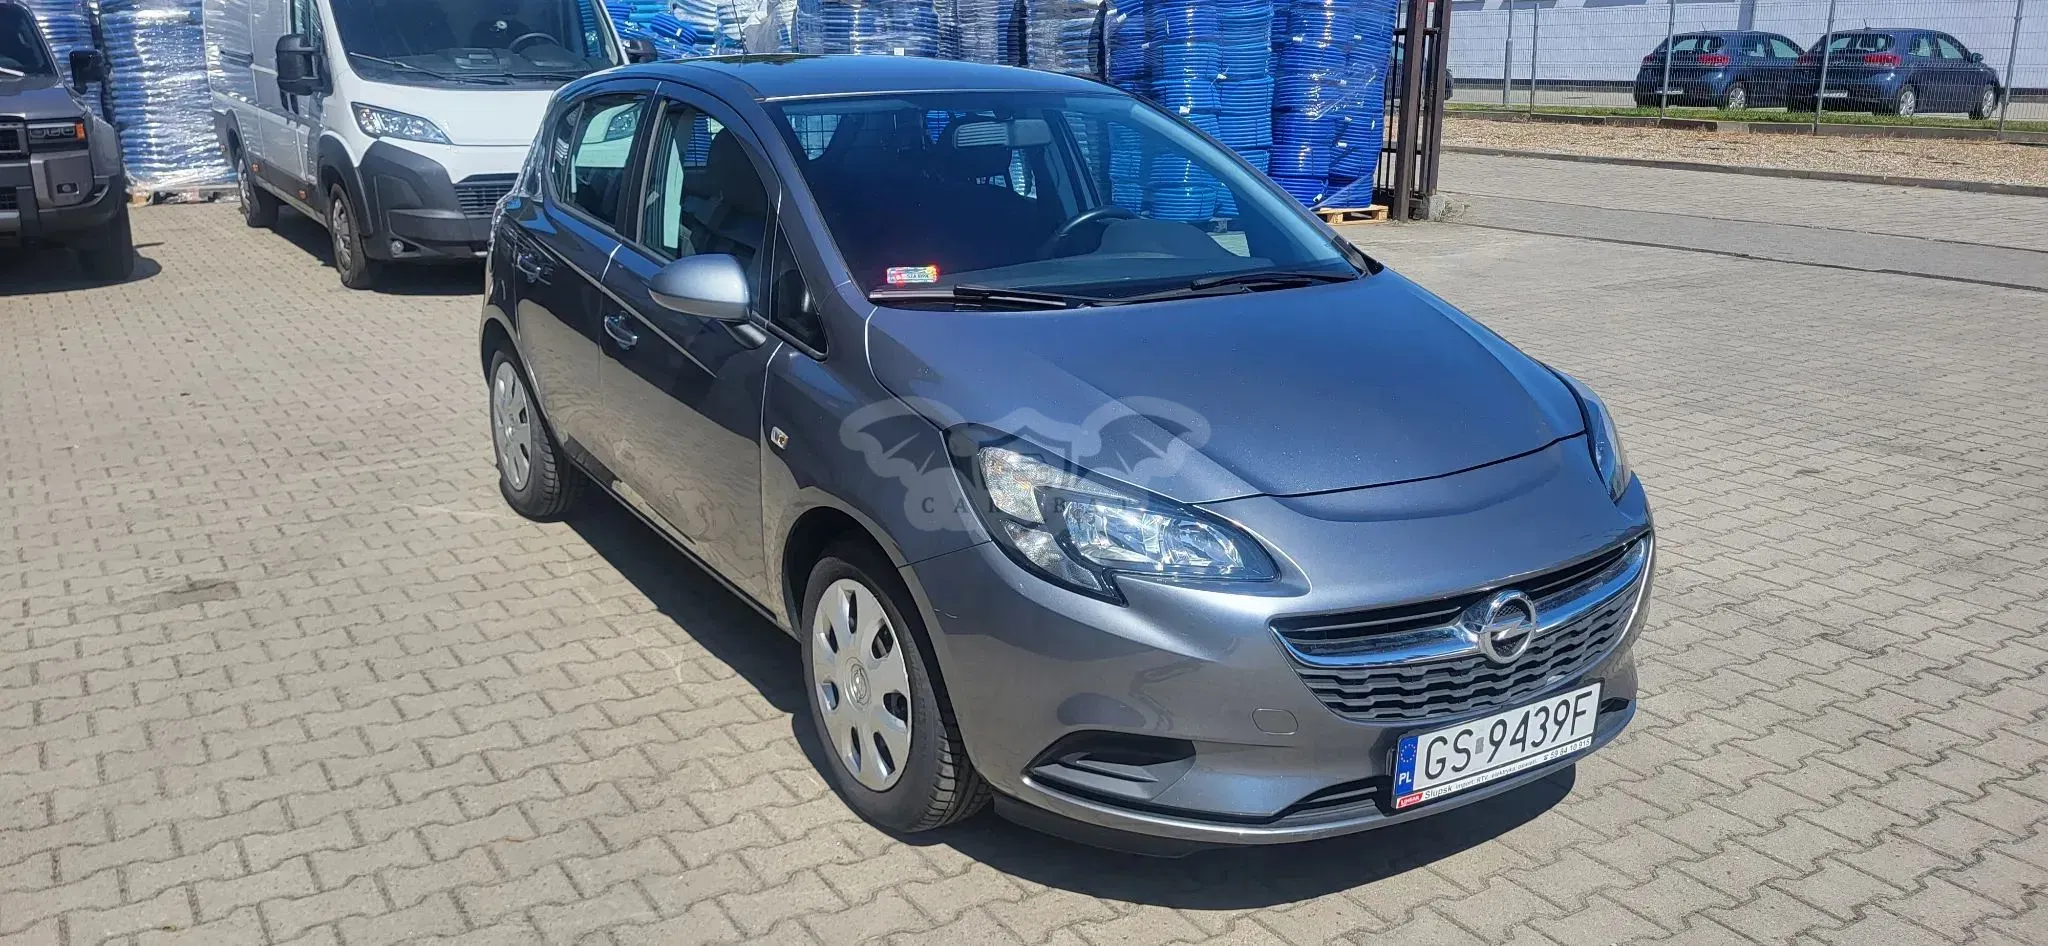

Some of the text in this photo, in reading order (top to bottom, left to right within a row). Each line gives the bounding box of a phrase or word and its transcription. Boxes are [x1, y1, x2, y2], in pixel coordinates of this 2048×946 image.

[1425, 691, 1592, 780] GS 9439F
[1399, 772, 1412, 784] PL
